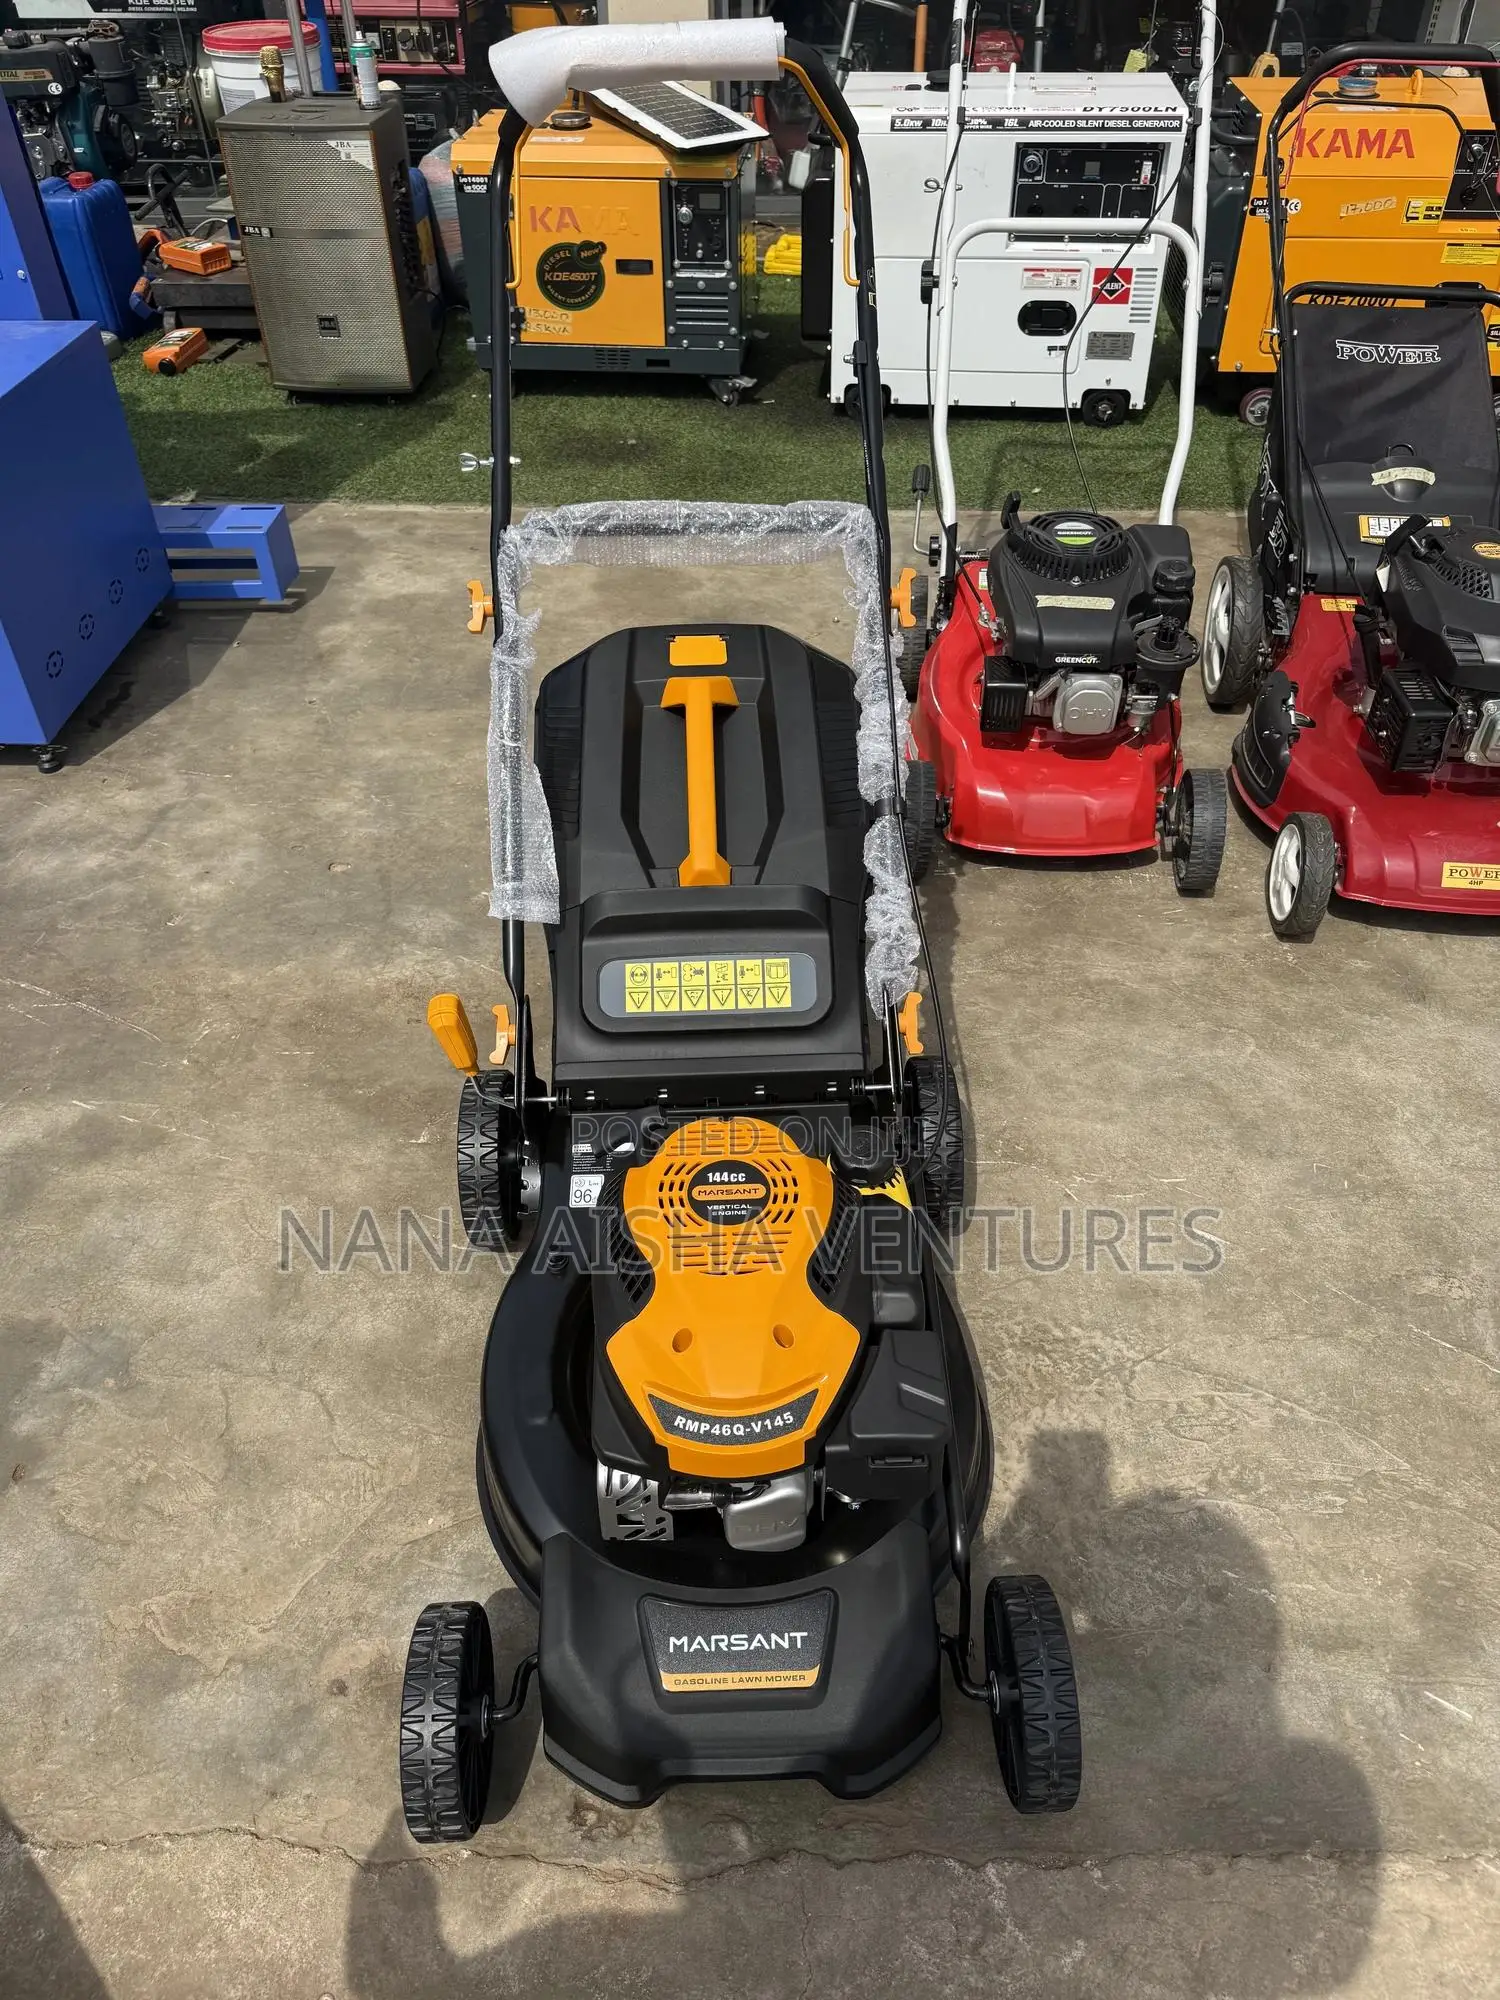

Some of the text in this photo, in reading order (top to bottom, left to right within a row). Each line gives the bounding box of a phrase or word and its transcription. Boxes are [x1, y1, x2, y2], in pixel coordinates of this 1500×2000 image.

[1004, 118, 1180, 128] 16L AIR-COOLED SILENT DIESEL GENERATOR
[1296, 128, 1415, 159] KAMA
[543, 249, 572, 271] DIESEL
[1336, 344, 1441, 364] POWER
[707, 1172, 746, 1182] 144cc
[698, 1188, 760, 1196] MARSANT
[674, 1412, 794, 1436] RMP46Q-V145
[669, 1631, 808, 1653] MARSANT
[674, 1673, 806, 1686] GASOLINE LAWN MOWER
